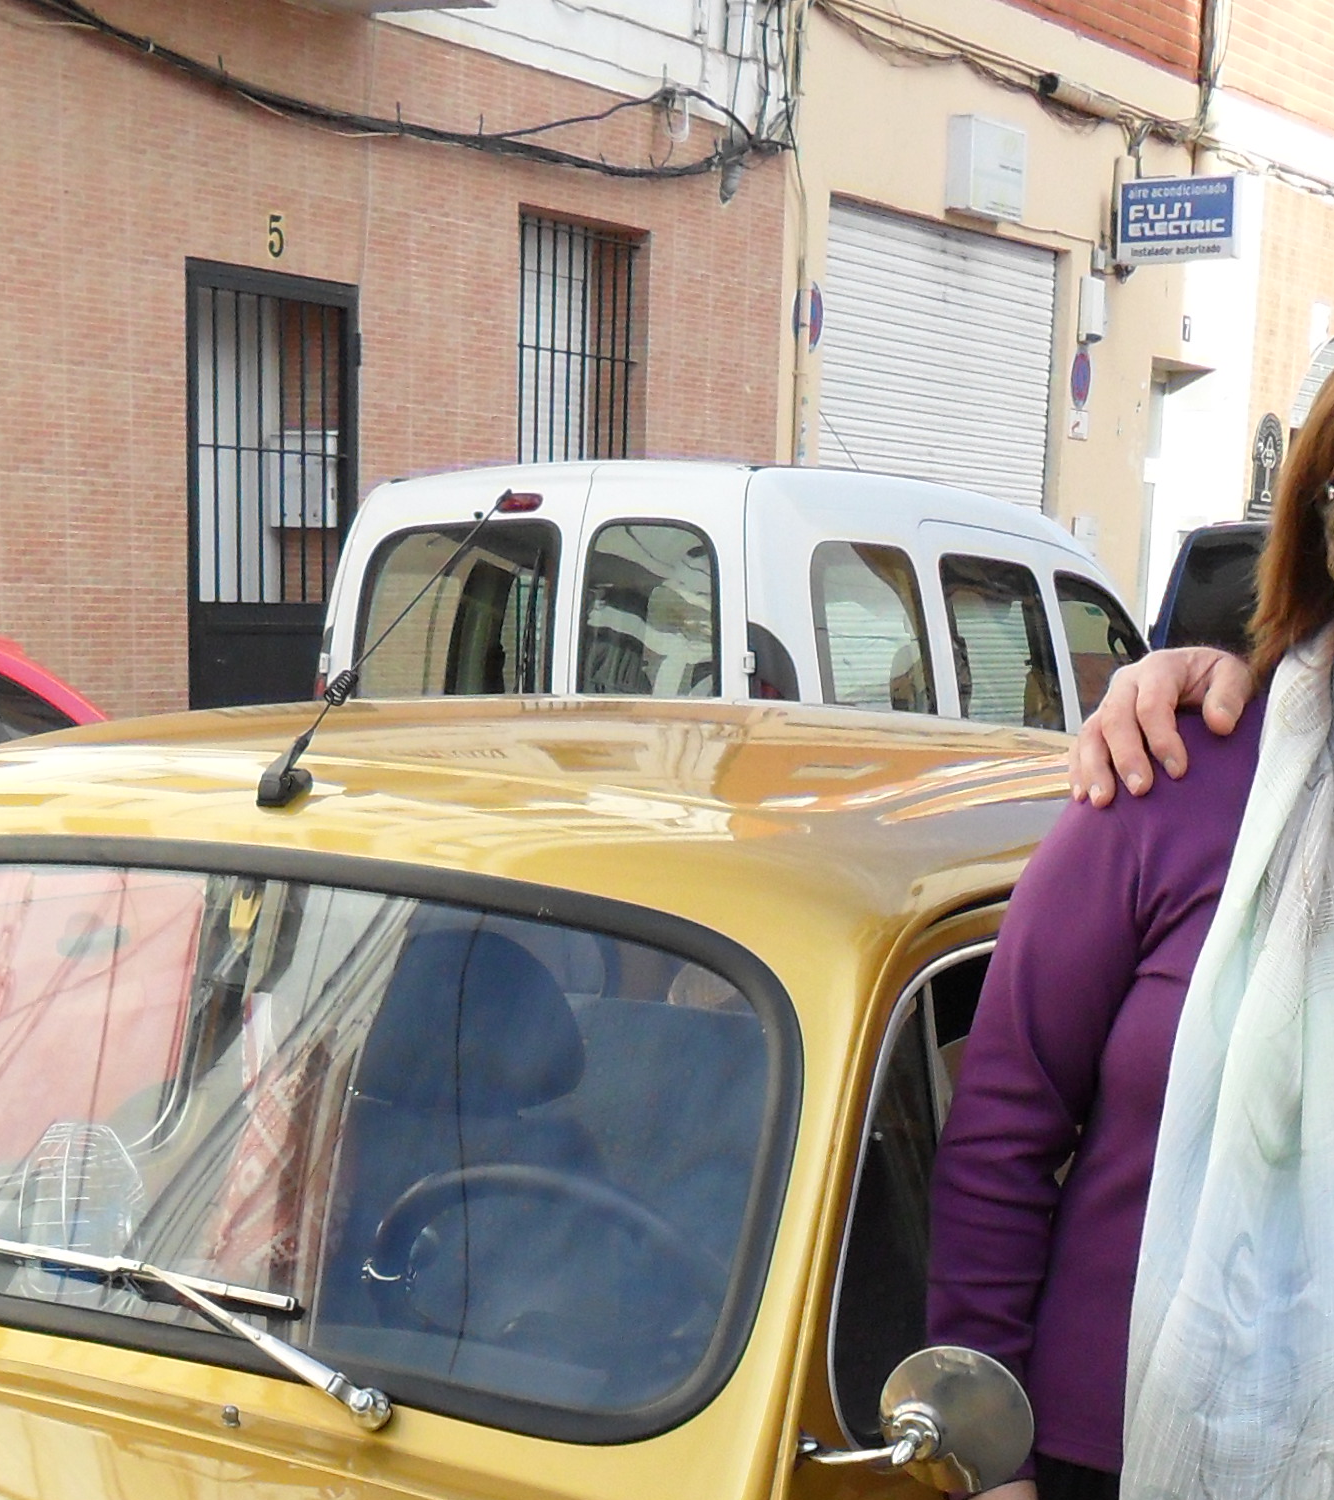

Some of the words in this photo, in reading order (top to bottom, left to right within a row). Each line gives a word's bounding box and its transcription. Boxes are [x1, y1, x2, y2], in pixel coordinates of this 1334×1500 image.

[1128, 186, 1149, 200] aire
[1151, 182, 1227, 198] acondicionado
[1129, 202, 1192, 221] FUJI
[268, 214, 284, 258] 5
[1128, 218, 1226, 237] ELECTRIC
[1131, 245, 1174, 257] instalador
[1176, 243, 1222, 255] autorizado
